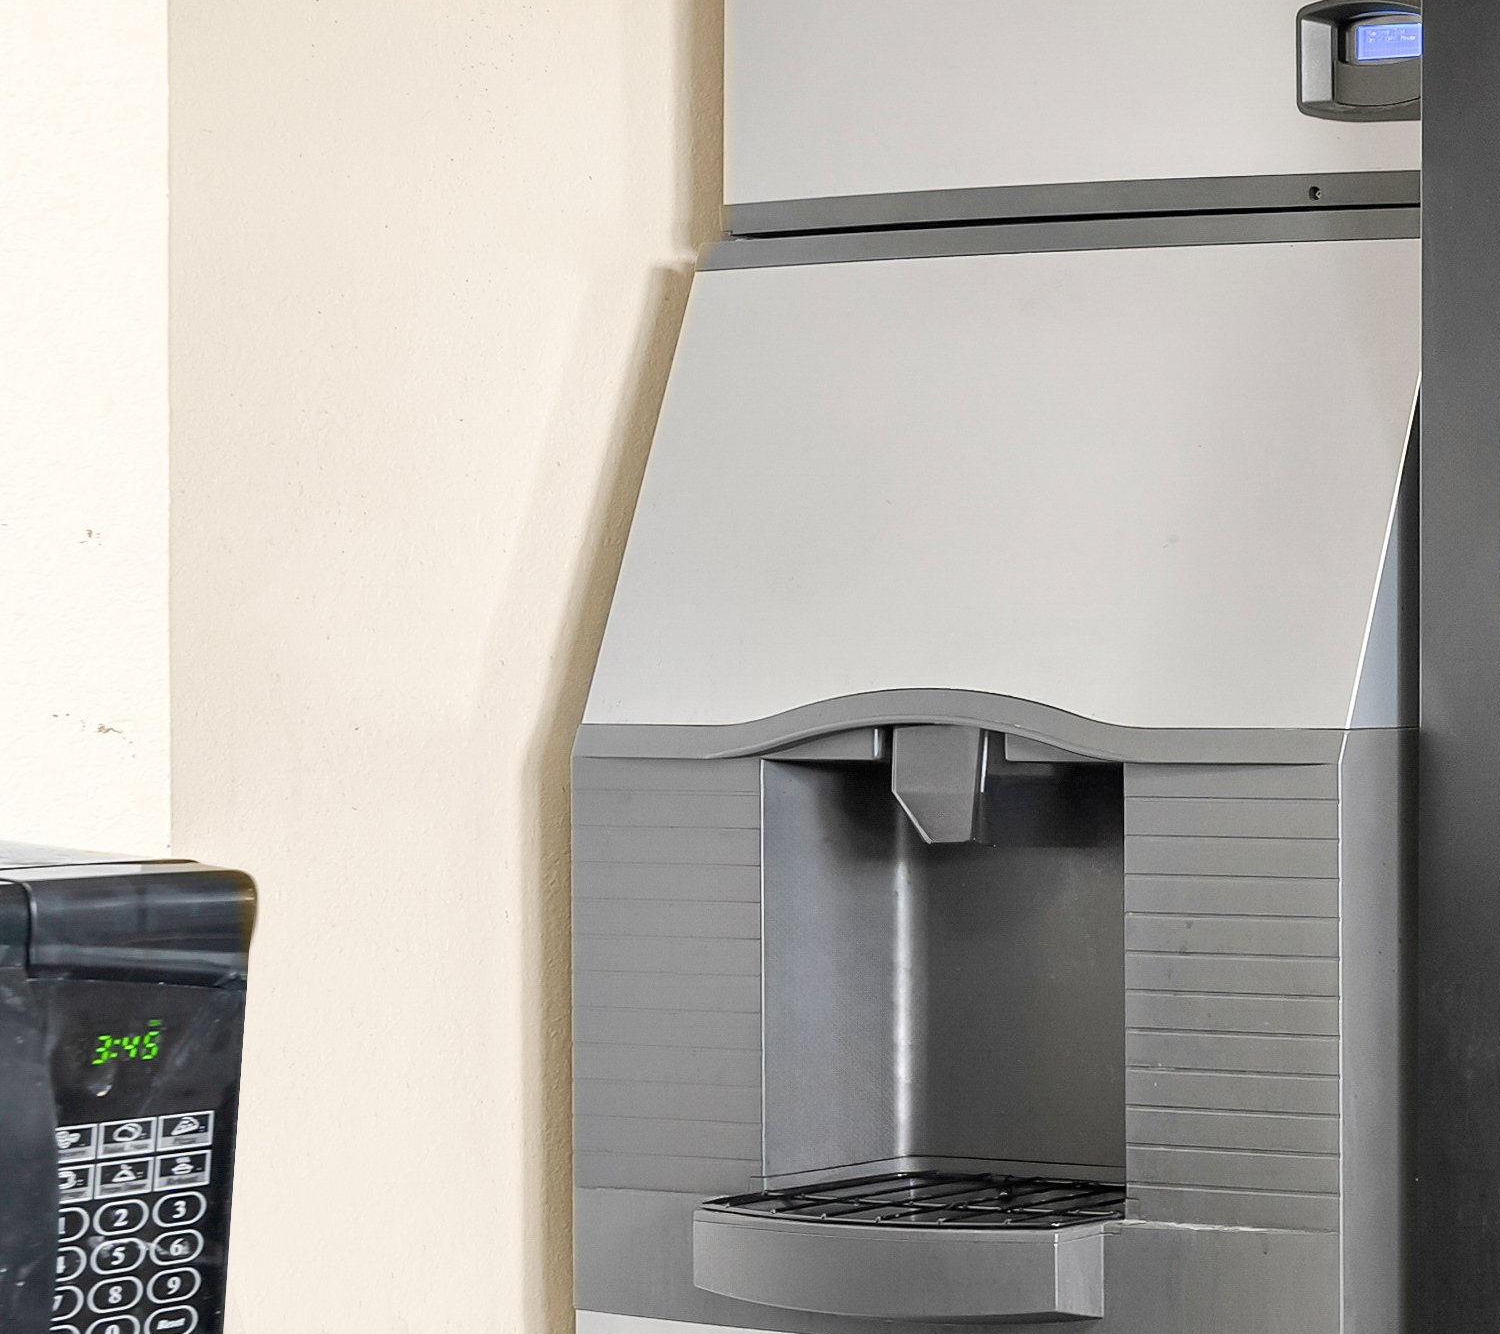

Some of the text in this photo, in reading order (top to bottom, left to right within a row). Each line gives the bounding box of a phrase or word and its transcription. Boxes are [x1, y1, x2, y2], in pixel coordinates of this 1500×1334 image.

[92, 1031, 161, 1065] 3:45
[113, 1208, 128, 1226] 2
[173, 1200, 187, 1218] 3
[111, 1247, 126, 1265] 5
[170, 1238, 184, 1256] 6
[167, 1276, 181, 1295] 9
[108, 1286, 122, 1304] 8
